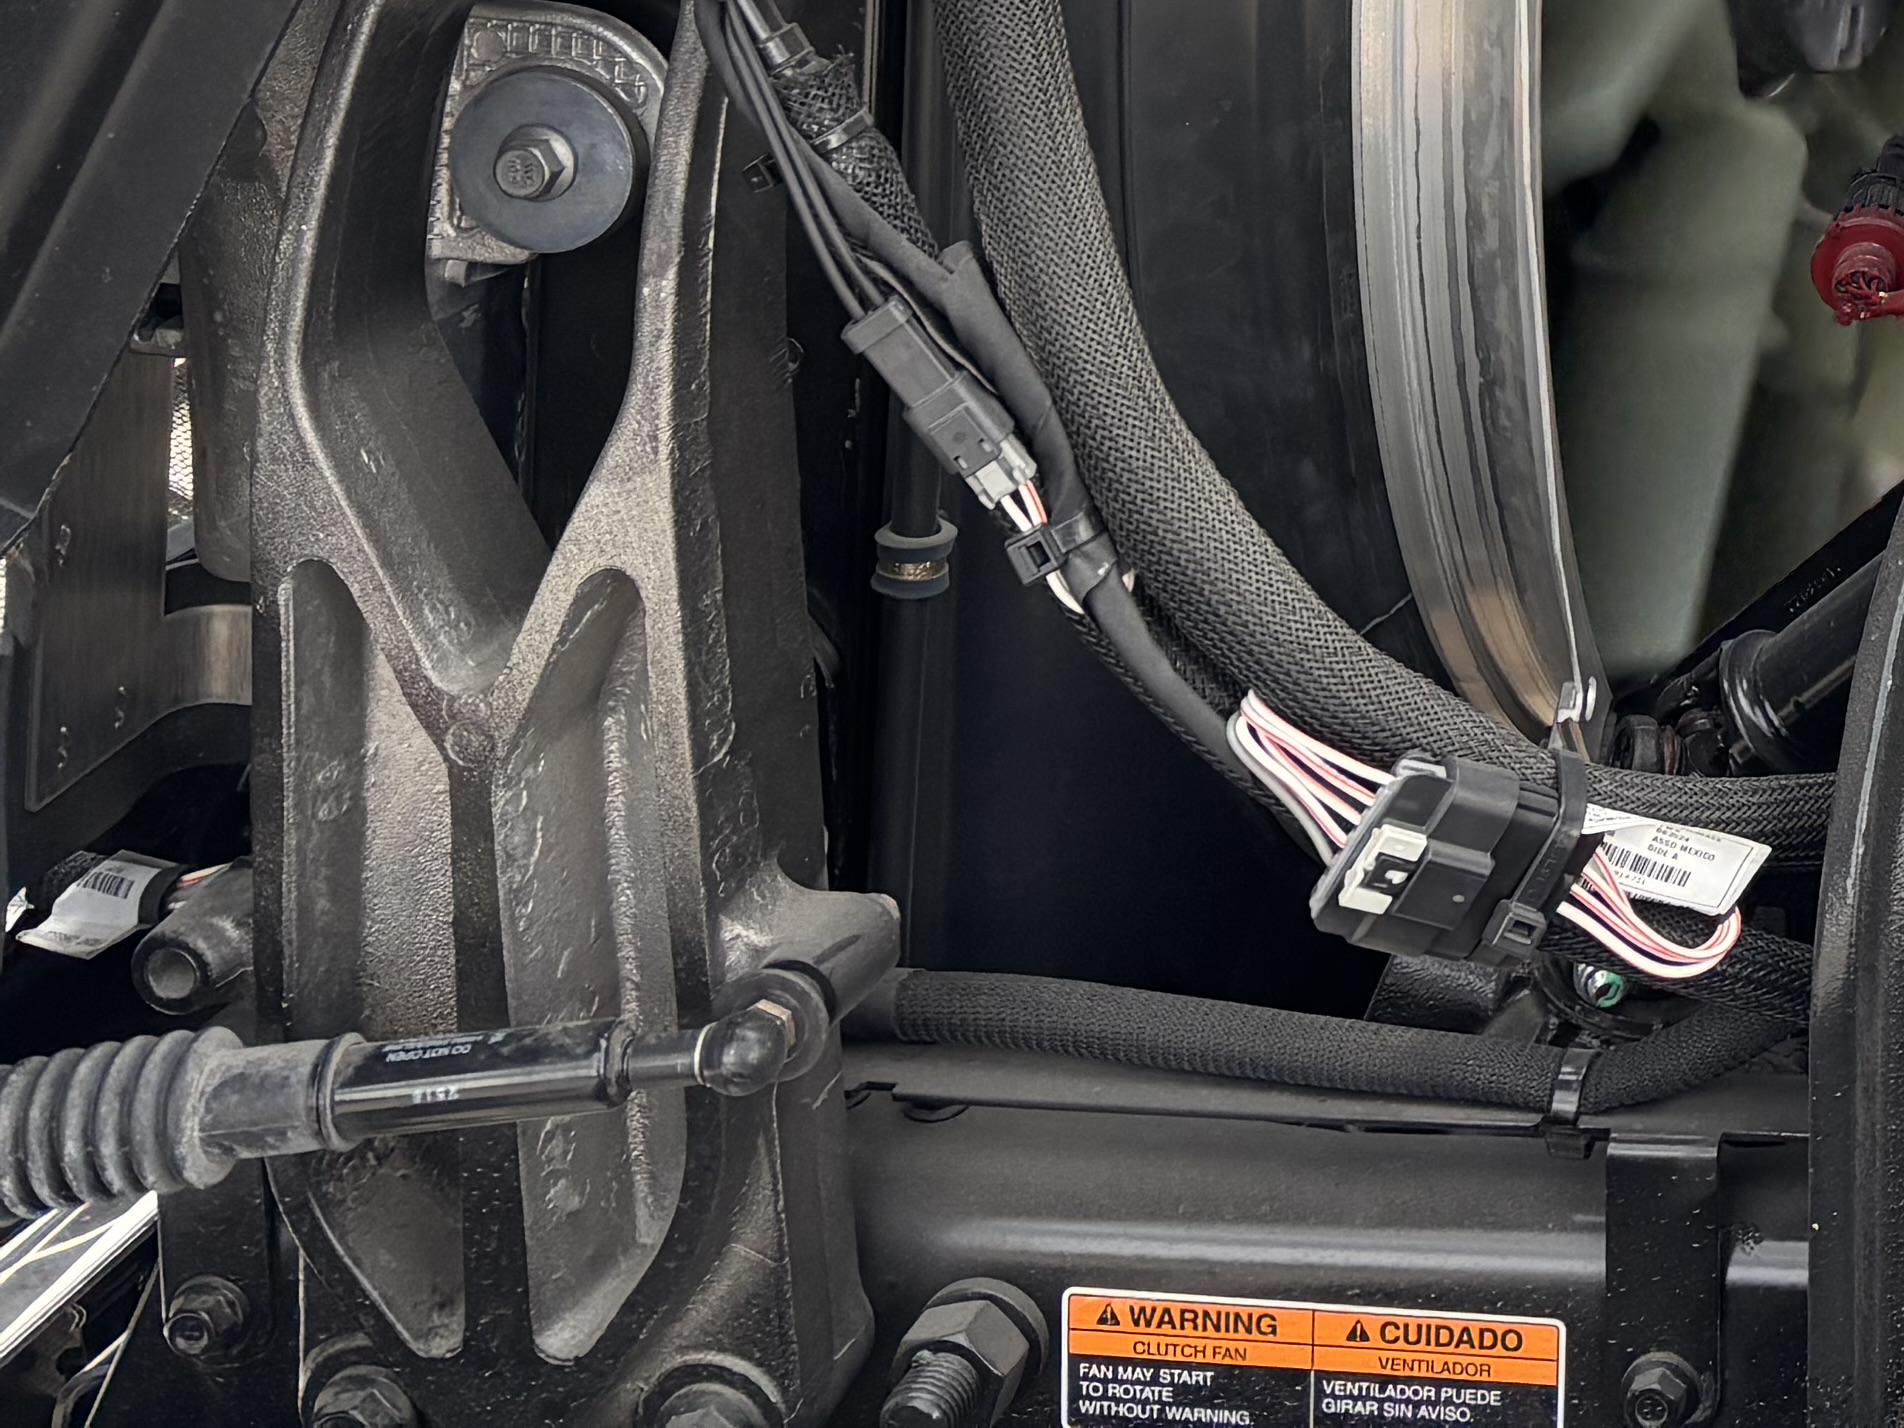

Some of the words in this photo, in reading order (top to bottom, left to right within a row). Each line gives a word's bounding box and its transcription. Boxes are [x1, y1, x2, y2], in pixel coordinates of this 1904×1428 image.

[1129, 1305, 1278, 1337] WARNING
[1380, 1321, 1524, 1352] CUIDADO
[1133, 1341, 1207, 1360] CLUTCH
[1211, 1345, 1247, 1361] FAN
[1079, 1364, 1113, 1381] FAN
[1117, 1366, 1153, 1383] MAY
[1159, 1369, 1215, 1387] START
[1378, 1356, 1492, 1378] VENTILADOR
[1080, 1382, 1099, 1397] TO
[1103, 1383, 1174, 1401] ROTATE
[1322, 1381, 1436, 1401] VENTILADOR
[1440, 1387, 1502, 1406] PUEDE
[1078, 1400, 1159, 1419] WITHOUT
[1164, 1404, 1255, 1426] WARNING.
[1322, 1400, 1377, 1416] GIRAR
[1382, 1403, 1415, 1418] SIN
[1418, 1404, 1475, 1423] AVISO.
